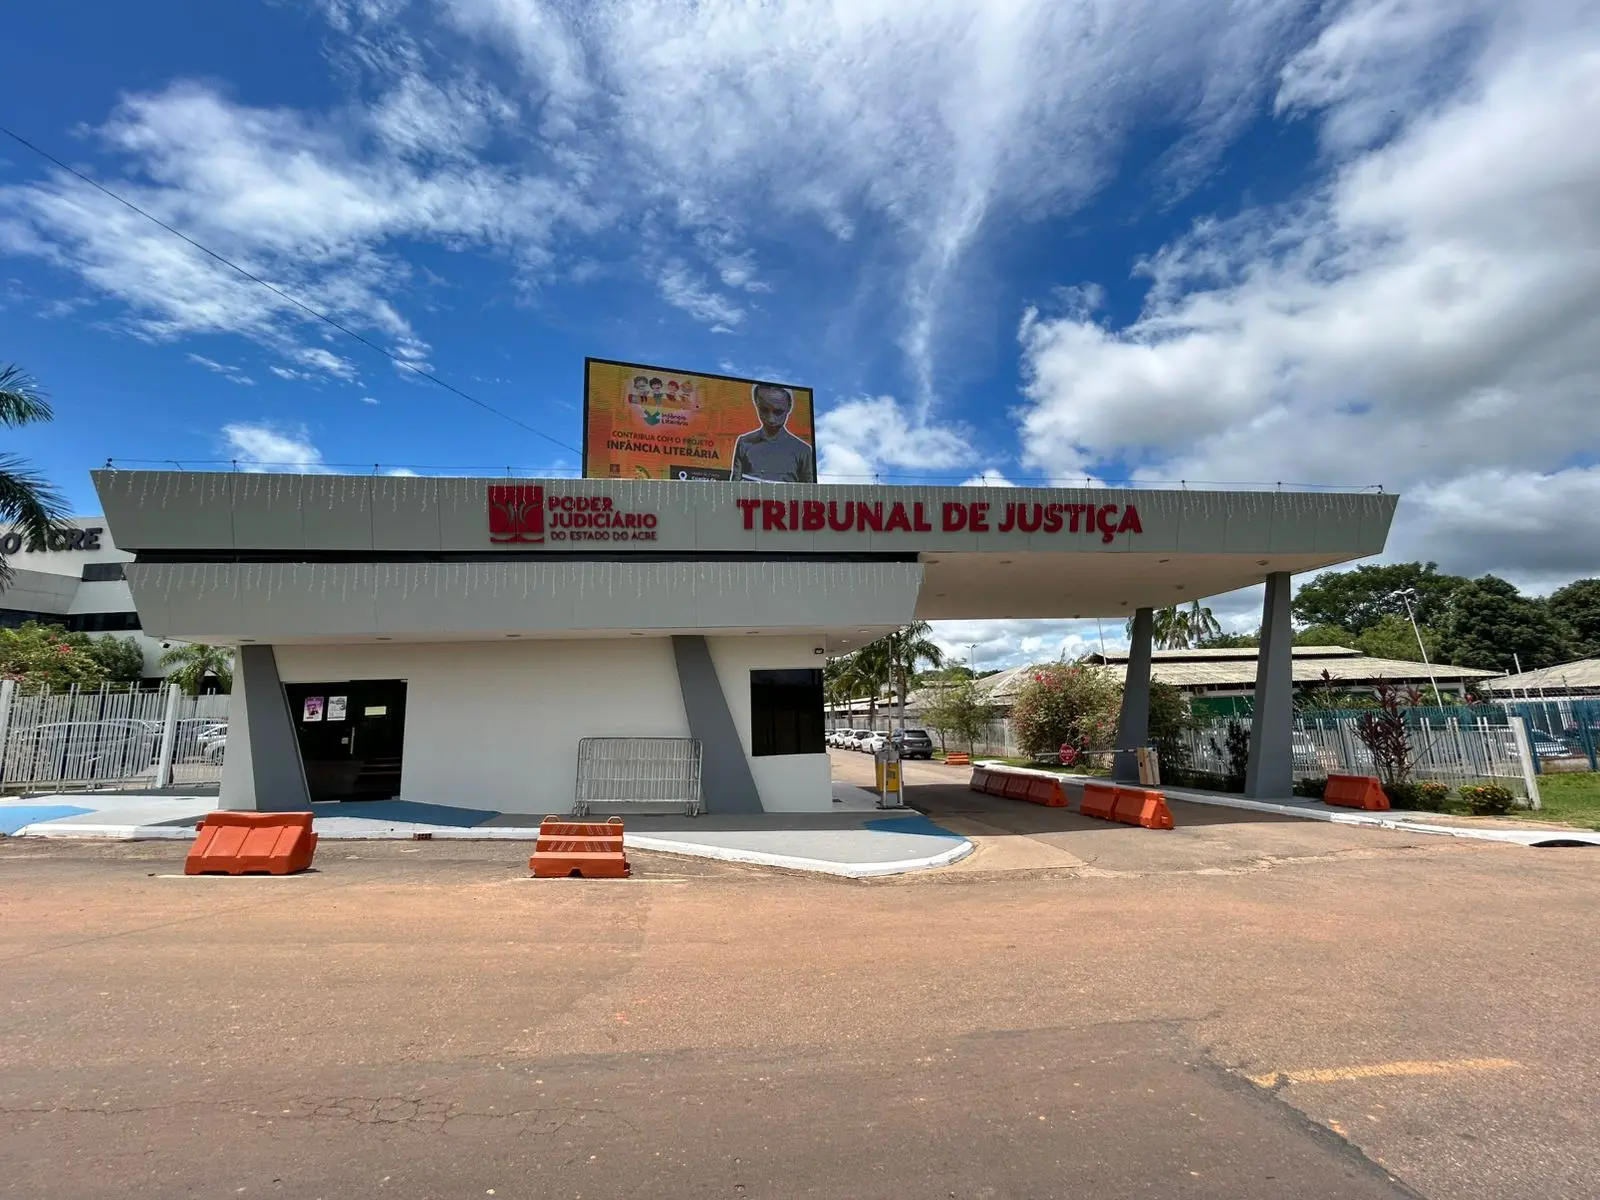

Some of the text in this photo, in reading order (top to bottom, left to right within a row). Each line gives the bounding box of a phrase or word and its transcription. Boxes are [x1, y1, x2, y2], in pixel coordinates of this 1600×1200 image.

[612, 430, 655, 441] CONTRIBUA
[657, 435, 674, 443] COM
[683, 438, 714, 447] PROJETO
[607, 439, 720, 460] INFÂNCIA LITERÁRIA
[548, 496, 613, 512] PODER
[549, 511, 658, 529] JUDICIÁRIO
[737, 499, 1143, 544] TRIBUNAL DE JUSTIÇA
[26, 528, 103, 552] ACRE
[551, 531, 658, 541] DO ESTADO DO ACRE
